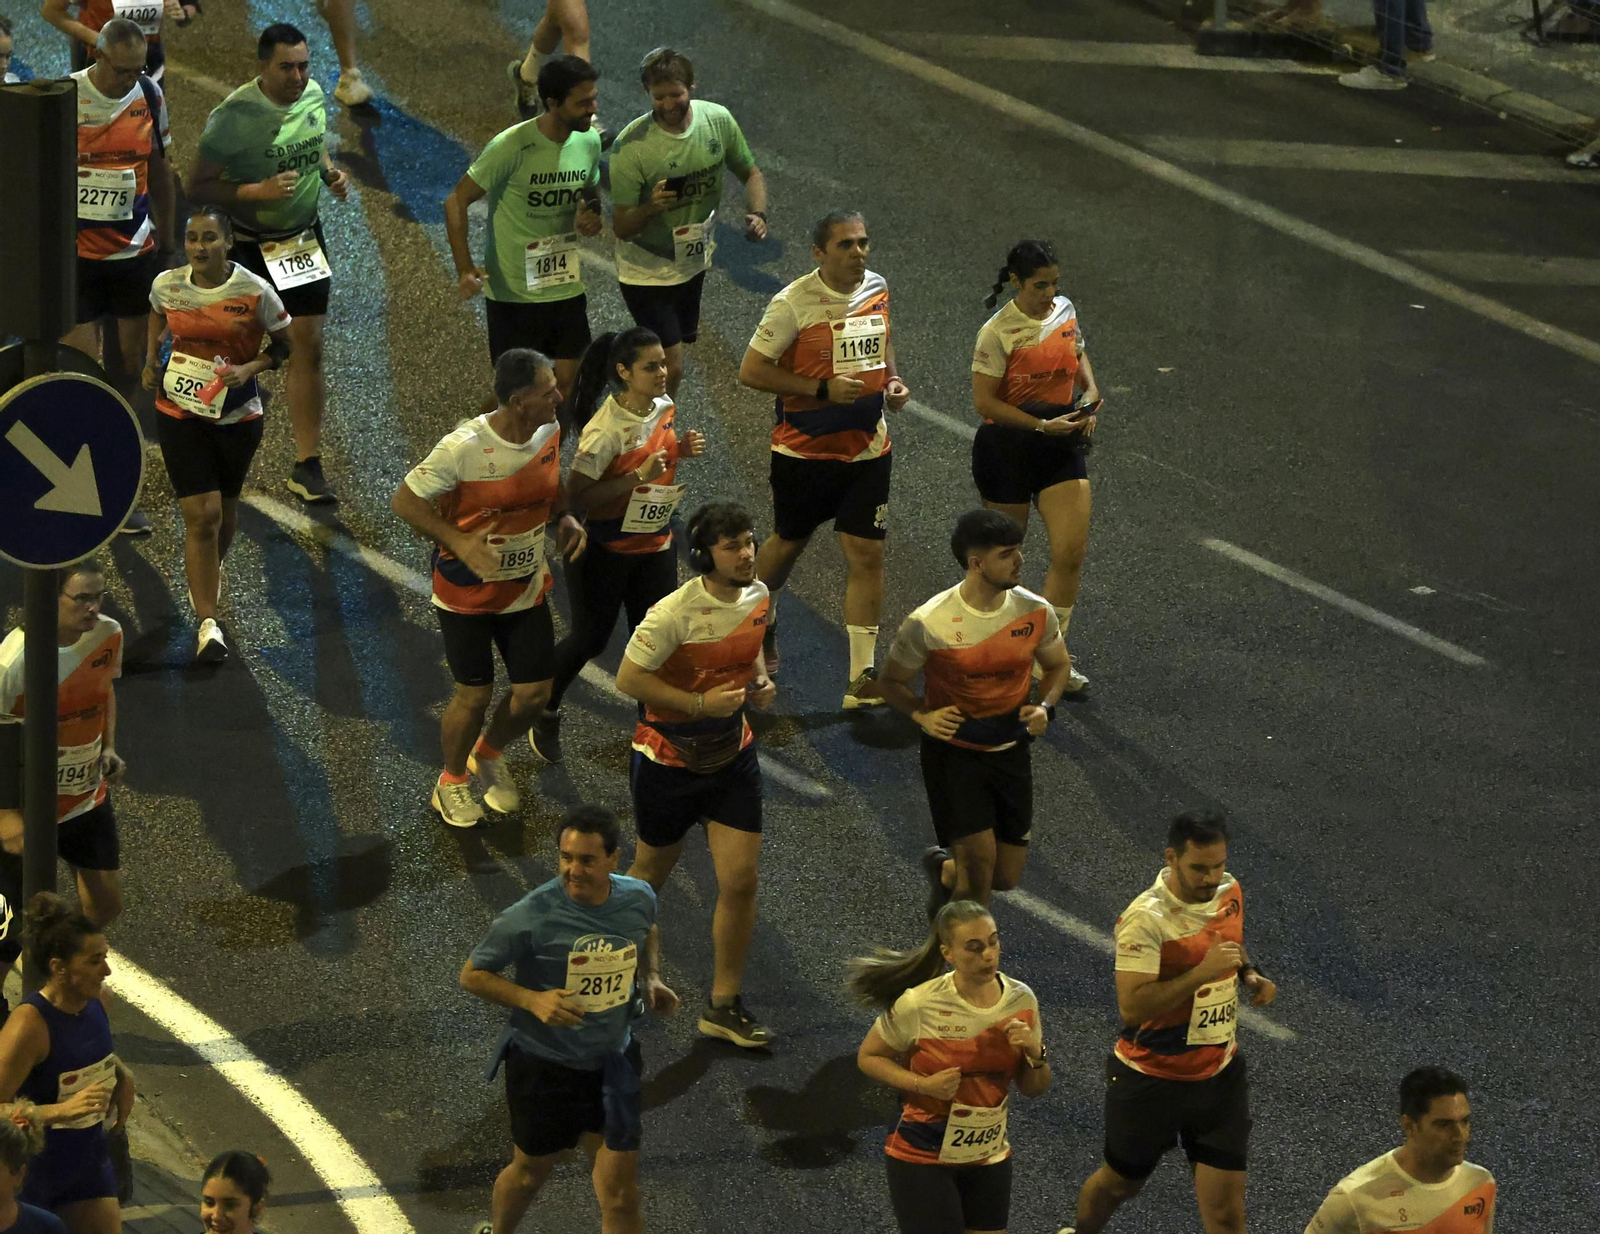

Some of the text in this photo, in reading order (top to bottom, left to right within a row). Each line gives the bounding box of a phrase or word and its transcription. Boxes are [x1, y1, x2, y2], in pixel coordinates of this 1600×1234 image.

[277, 150, 320, 173] sano
[530, 170, 586, 185] RUNNING
[79, 189, 127, 206] 22775
[279, 253, 314, 274] 1788
[536, 254, 567, 274] 1814
[841, 338, 879, 358] 11185
[640, 503, 672, 519] 1899
[500, 548, 534, 567] 1895
[1011, 626, 1031, 638] KH7
[579, 974, 623, 996] 2812
[951, 1124, 1002, 1147] 24499
[1464, 1202, 1484, 1216] KH7
